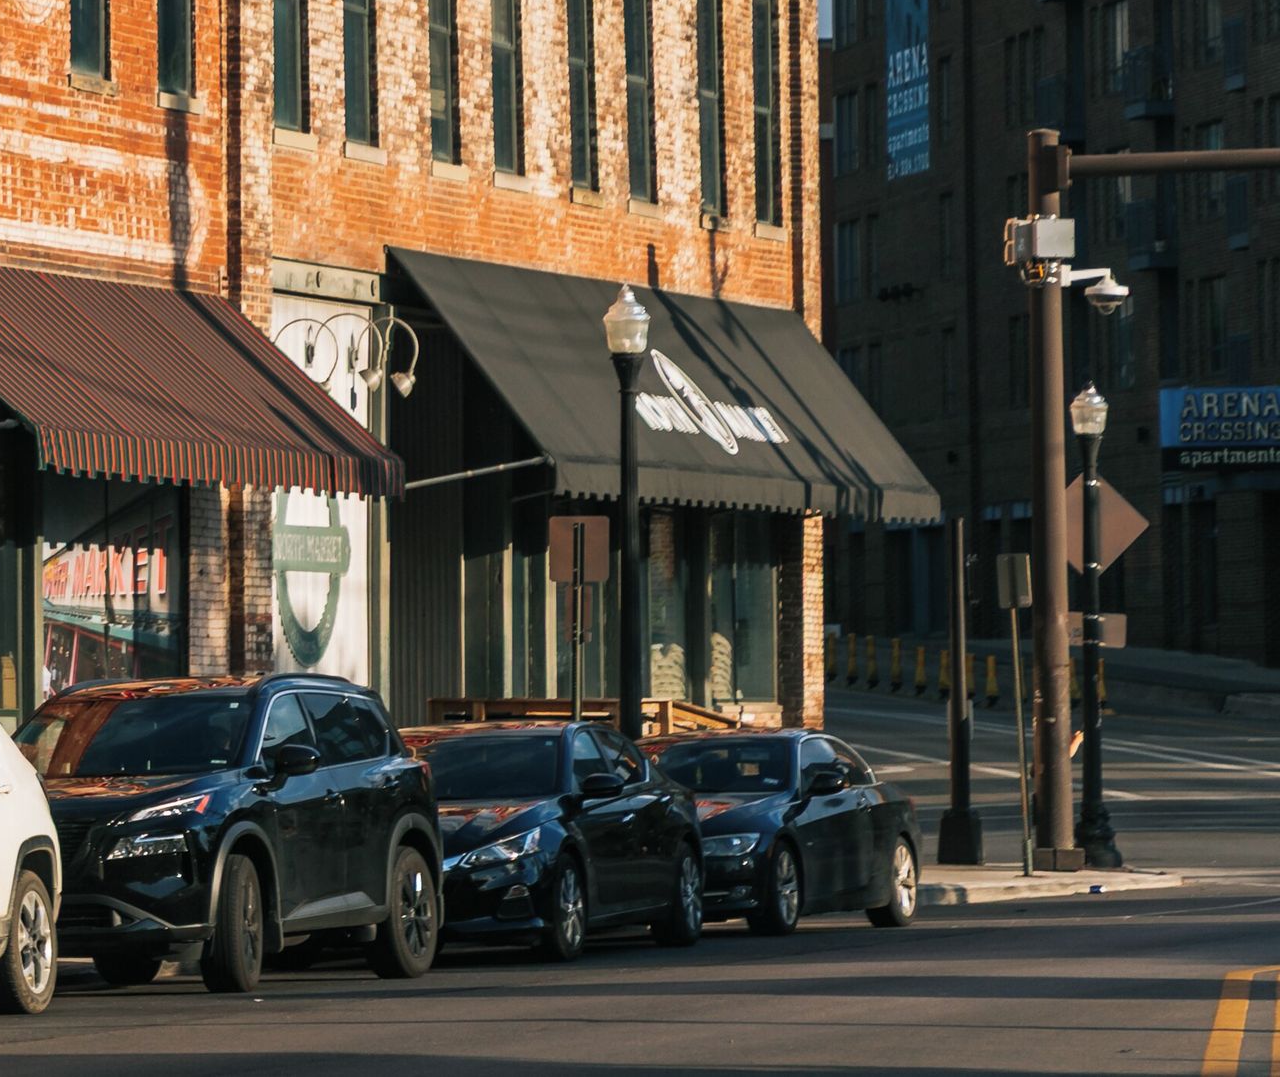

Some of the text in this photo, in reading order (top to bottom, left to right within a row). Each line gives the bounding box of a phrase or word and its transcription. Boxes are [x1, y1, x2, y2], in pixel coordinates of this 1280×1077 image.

[887, 41, 929, 89] ARENA
[1181, 392, 1280, 418] ARENA
[1179, 421, 1280, 442] CROSSING
[72, 512, 176, 597] MARKET
